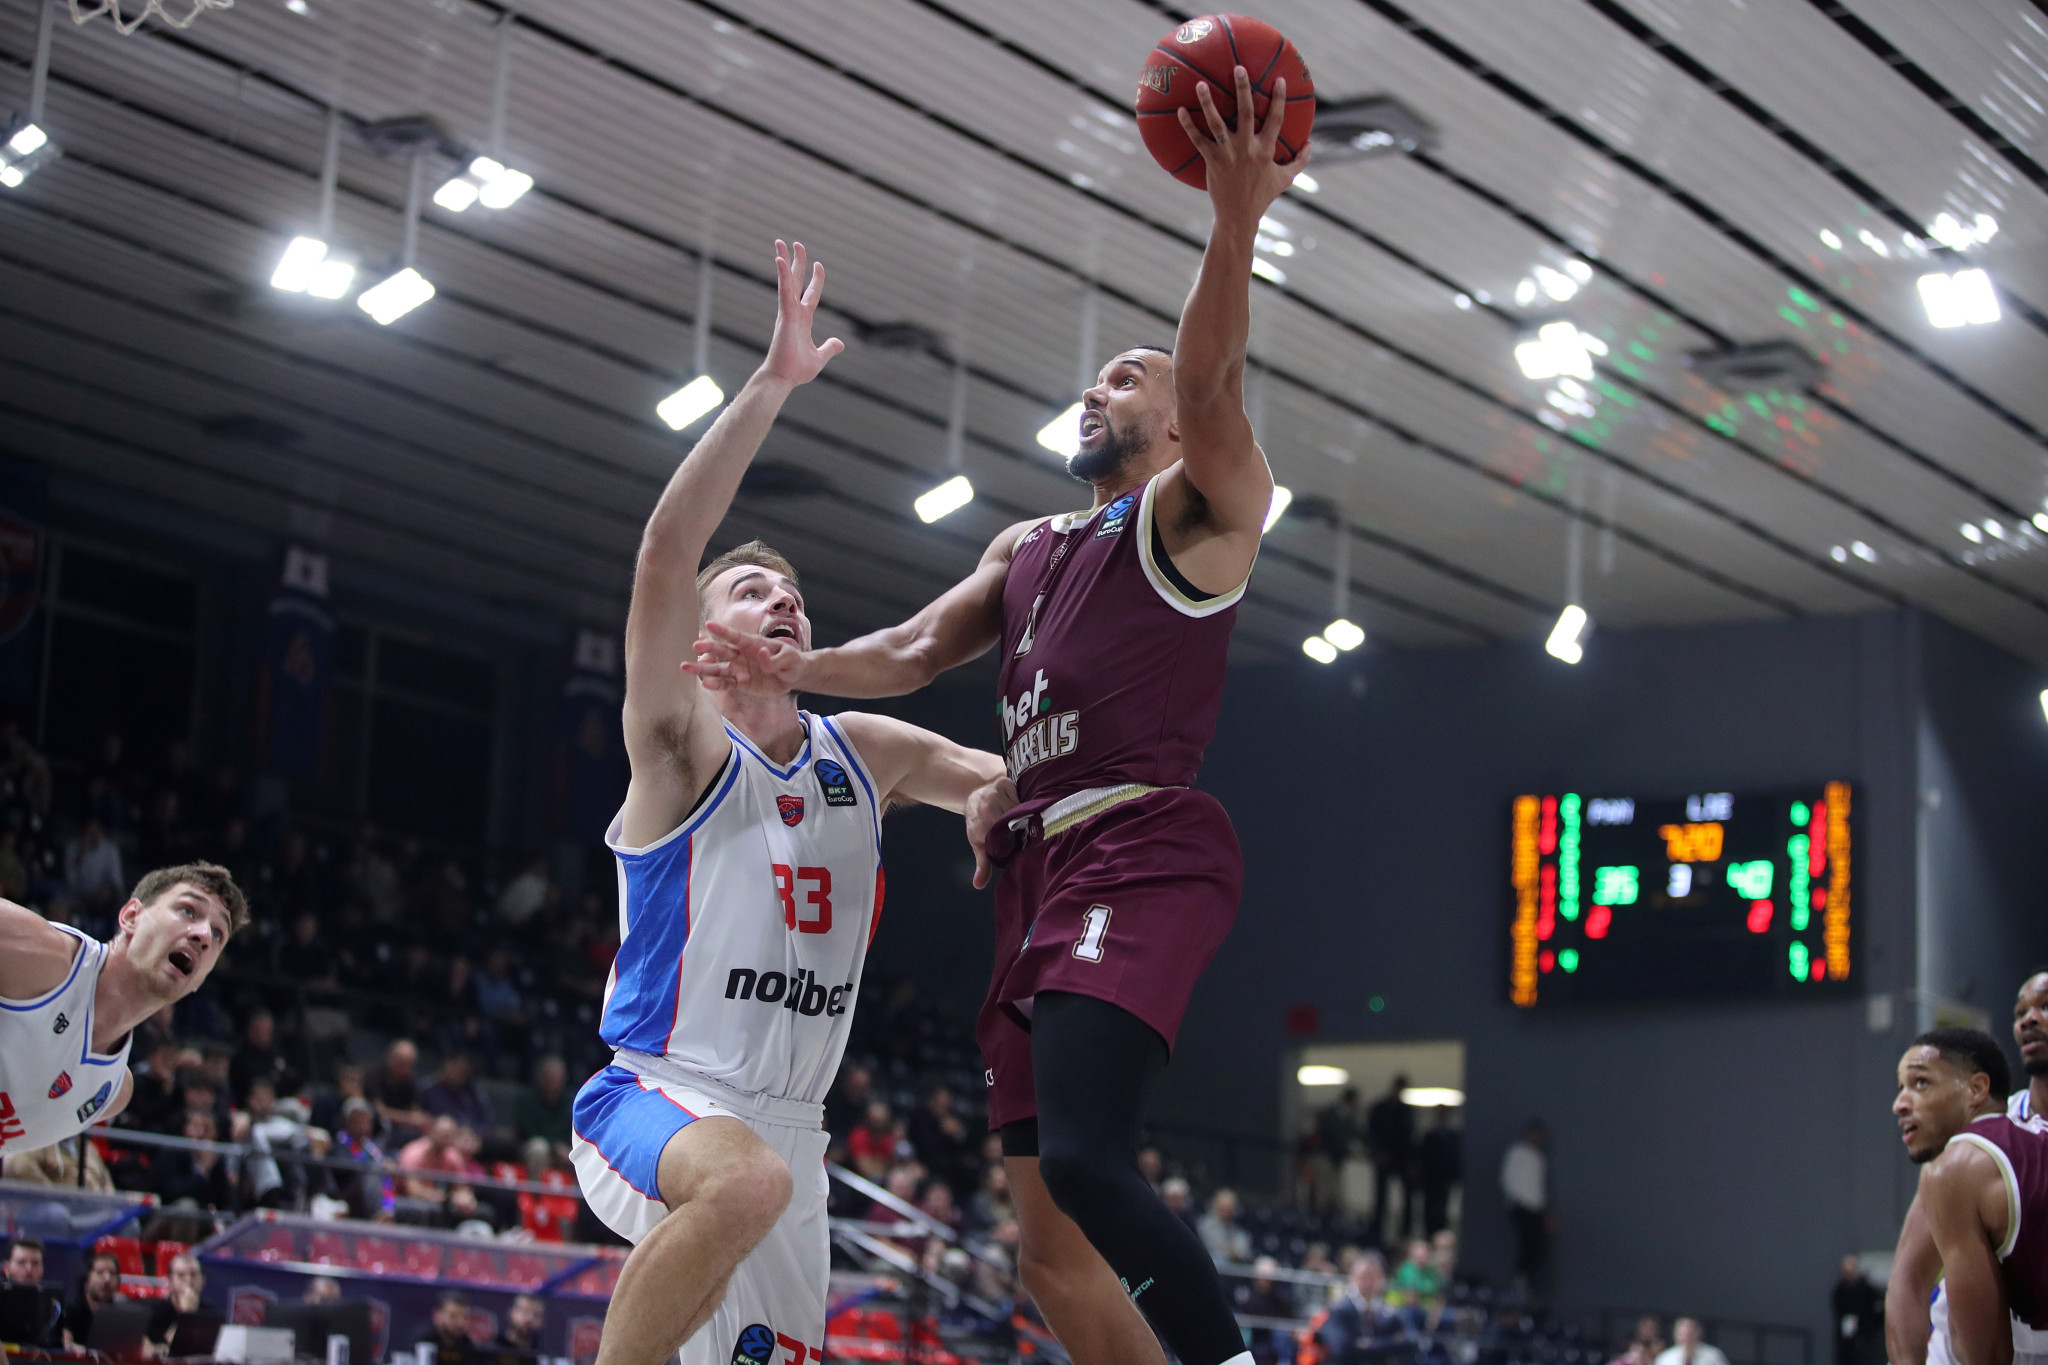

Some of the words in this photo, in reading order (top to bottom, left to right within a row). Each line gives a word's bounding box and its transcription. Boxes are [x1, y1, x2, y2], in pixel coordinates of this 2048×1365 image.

[1096, 526, 1124, 537] EuroCup
[828, 786, 847, 795] BKT
[827, 795, 854, 803] EuroCup
[1072, 903, 1112, 963] 1
